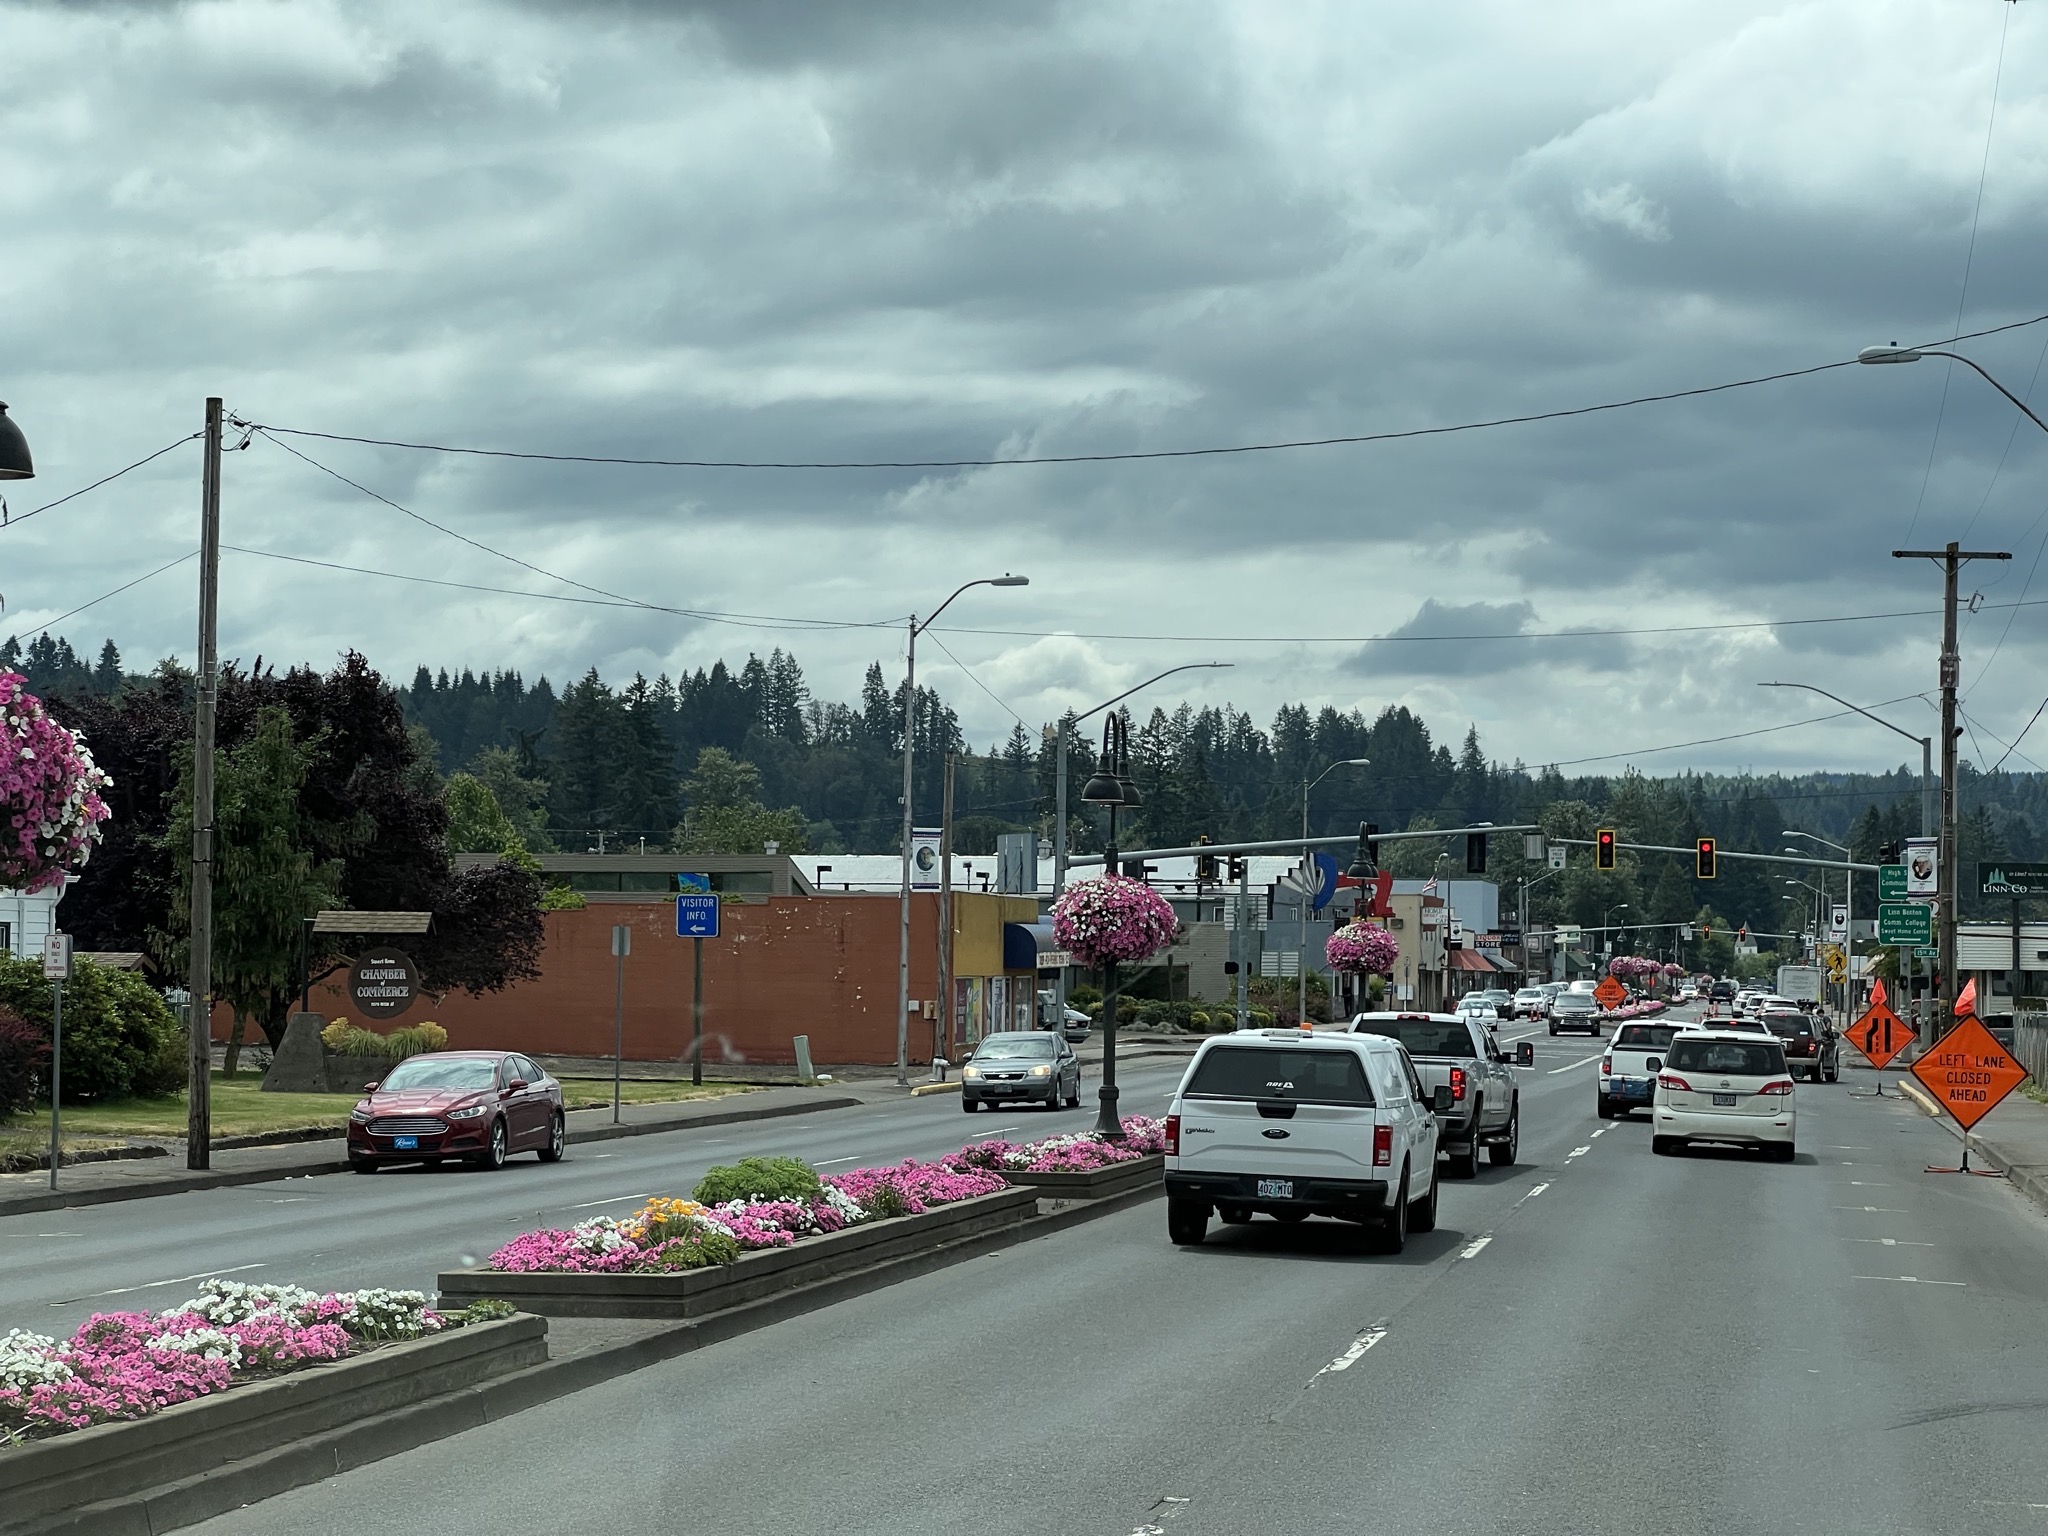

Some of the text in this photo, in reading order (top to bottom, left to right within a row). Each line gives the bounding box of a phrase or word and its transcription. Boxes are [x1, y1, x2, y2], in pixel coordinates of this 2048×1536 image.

[1888, 870, 1901, 878] High
[681, 898, 714, 908] VISITOR
[1906, 919, 1926, 928] College
[360, 968, 406, 980] CHAMBER
[356, 986, 408, 997] COMMERCE
[1940, 1054, 2006, 1068] LEFT LANE
[1946, 1072, 1990, 1084] CLOSED
[1949, 1088, 1986, 1102] AHEAD
[1258, 1184, 1273, 1194] 402
